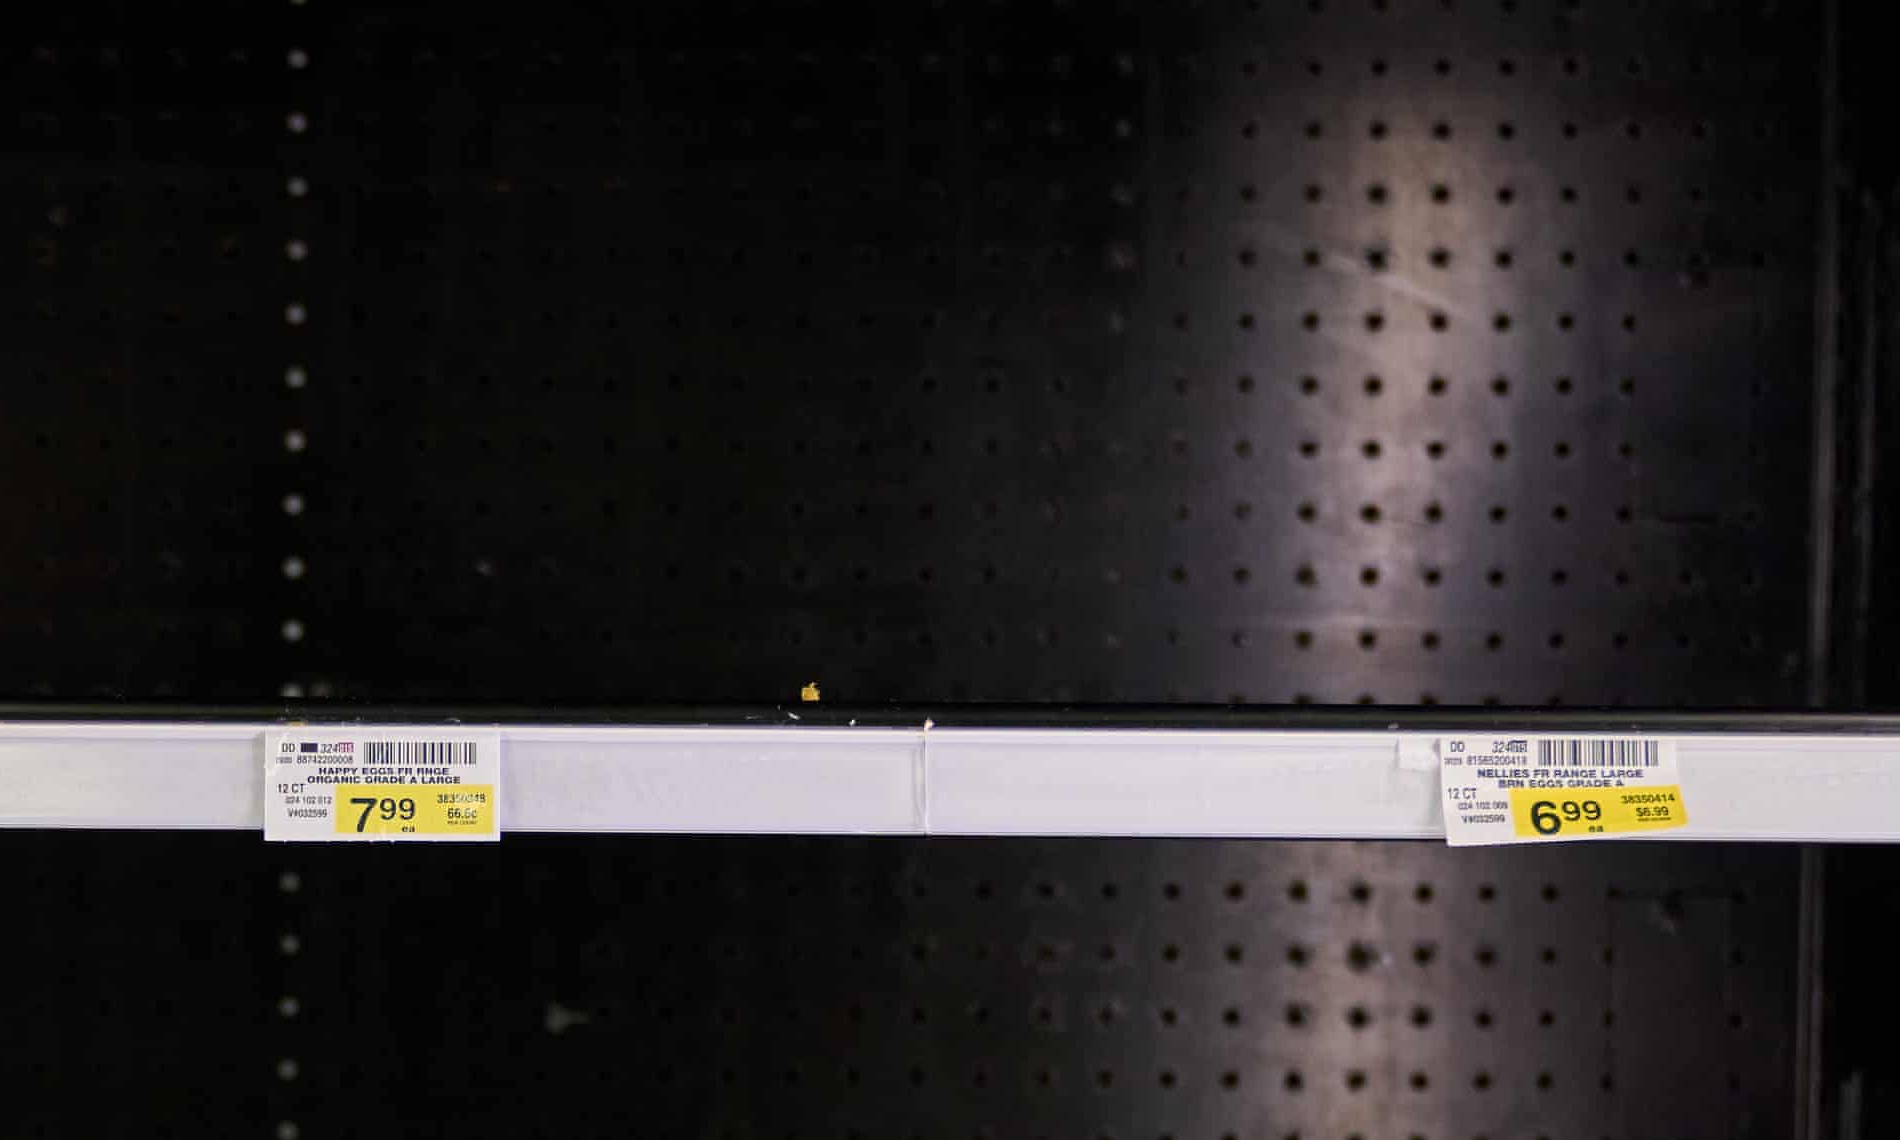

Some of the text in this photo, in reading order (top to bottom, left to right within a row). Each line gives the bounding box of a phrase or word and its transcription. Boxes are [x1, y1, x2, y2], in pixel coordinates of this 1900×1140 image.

[319, 767, 358, 776] HAPPY
[362, 767, 394, 776] EGGS
[1477, 769, 1529, 779] NELLIES
[1554, 769, 1596, 779] RANGE
[1601, 769, 1644, 779] LARGE
[307, 775, 461, 784] ORGANIC GRADE A LARGE
[1529, 779, 1563, 788] EGGS
[1568, 779, 1610, 788] GRADE
[1615, 779, 1624, 787] A
[278, 784, 305, 794] 12 CT
[1448, 788, 1476, 799] 12 CT
